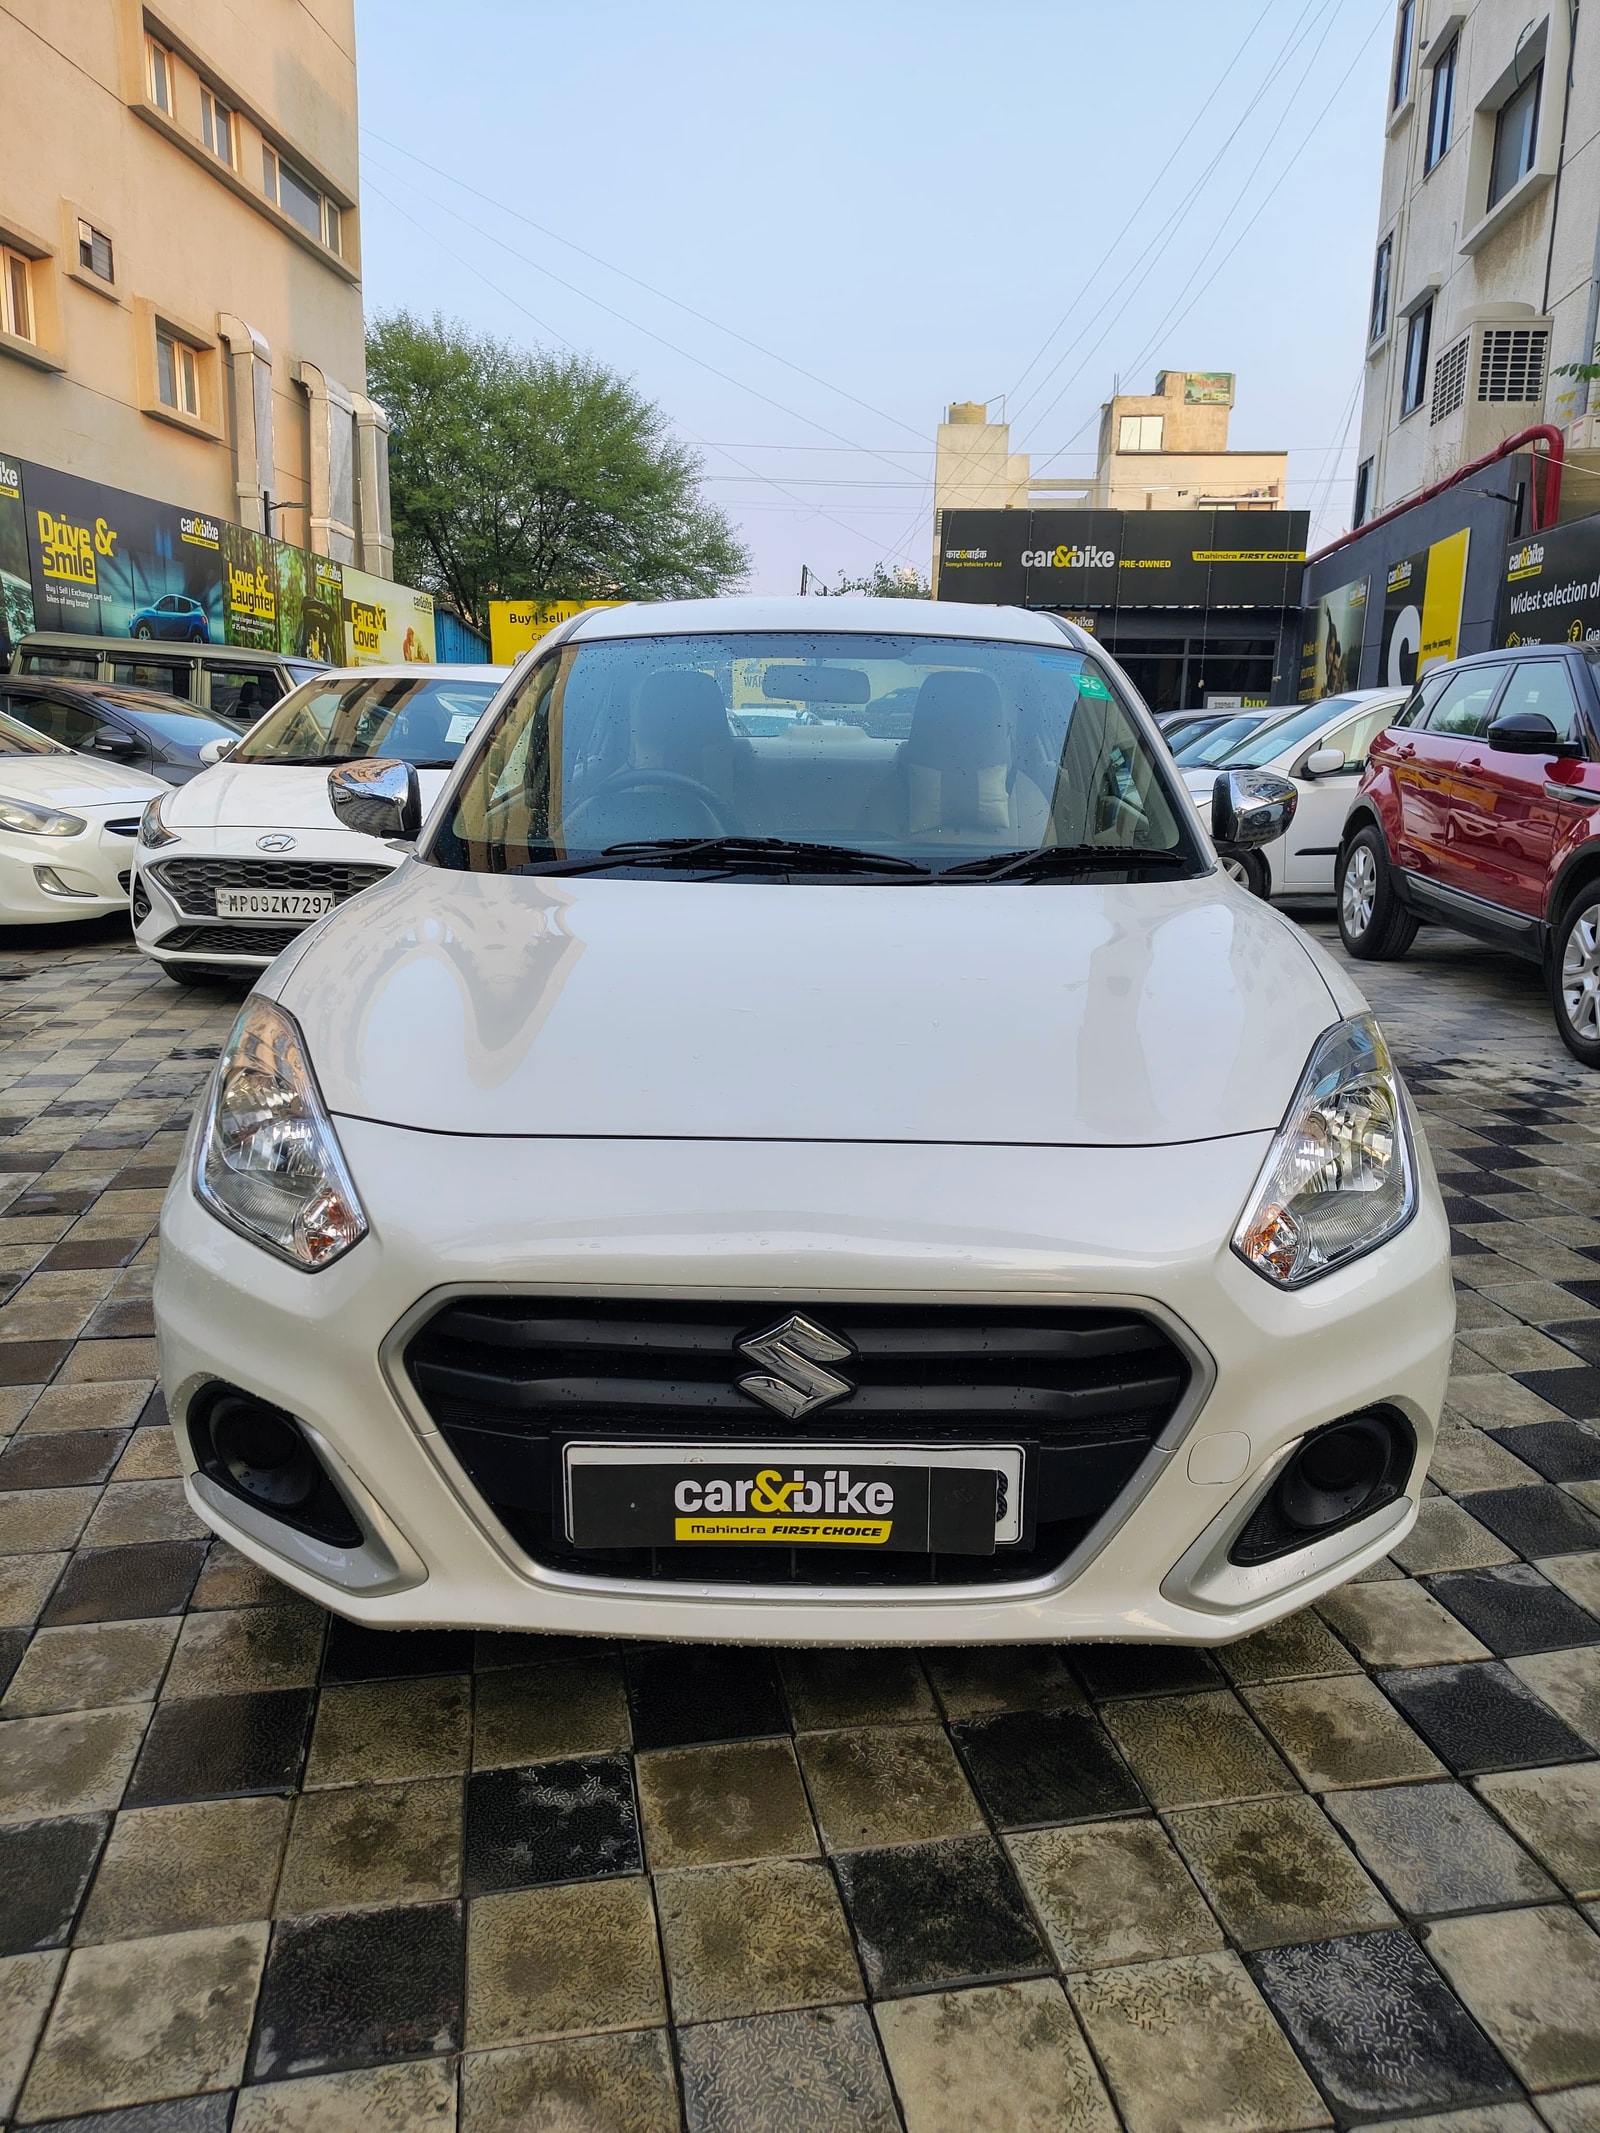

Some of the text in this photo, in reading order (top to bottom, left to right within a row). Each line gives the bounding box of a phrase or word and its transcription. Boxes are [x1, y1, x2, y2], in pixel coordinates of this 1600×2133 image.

[38, 511, 117, 557] Drive &
[180, 517, 219, 541] car&bike
[41, 542, 94, 579] Smile
[1021, 545, 1115, 568] car&bike
[1119, 560, 1171, 568] PRE-OWNED
[1509, 543, 1544, 571] car&bike
[229, 563, 268, 592] Love &
[45, 584, 56, 595] Buy
[59, 586, 68, 595] Sell
[71, 588, 93, 601] Exchange
[231, 584, 274, 612] Laughter
[1510, 590, 1541, 615] Widest
[1542, 580, 1588, 609] selection
[351, 602, 374, 628] Care
[509, 613, 531, 625] Buy
[542, 611, 563, 623] Sell
[353, 624, 379, 649] Cover
[229, 895, 331, 914] MP09ZK7297
[674, 1469, 894, 1514] car&bike
[690, 1524, 882, 1537] Mahindra FIRST CHOICE
